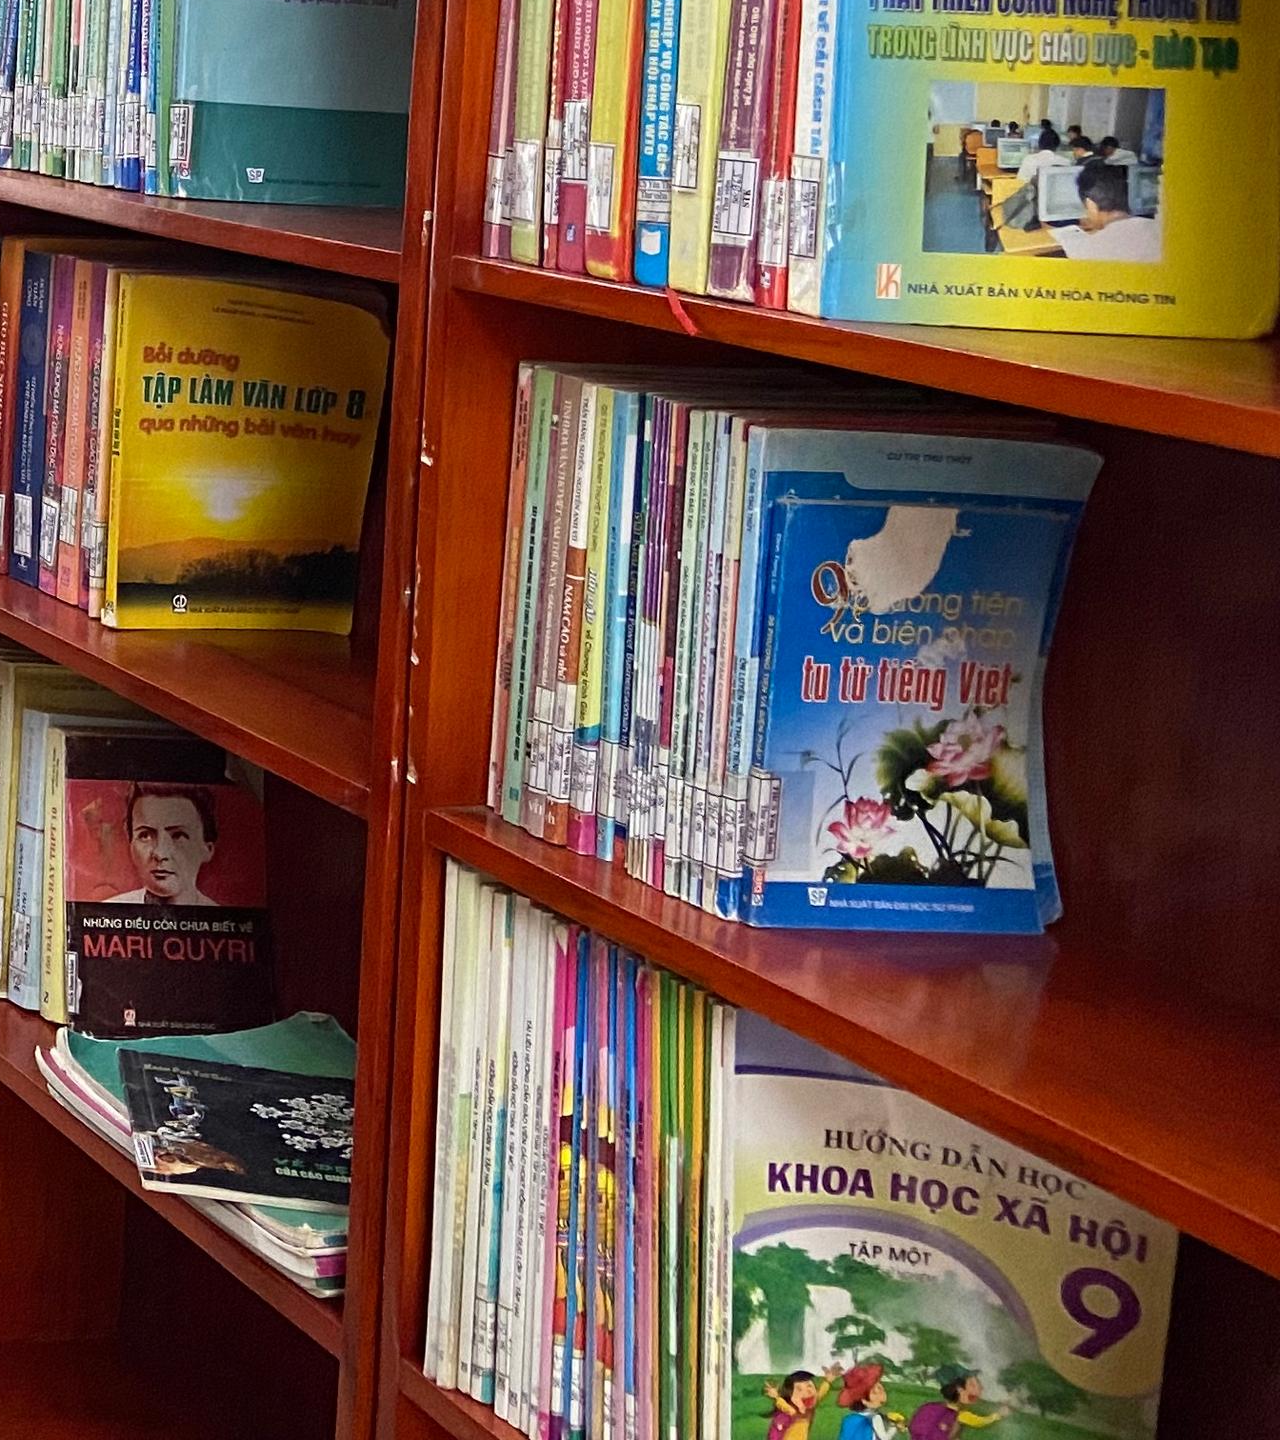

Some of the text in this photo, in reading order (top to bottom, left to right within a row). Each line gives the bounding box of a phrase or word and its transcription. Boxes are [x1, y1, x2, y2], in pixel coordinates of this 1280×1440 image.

[868, 25, 936, 60] TRONG
[940, 22, 987, 62] LĨNH
[991, 31, 1033, 72] VỰC
[1039, 27, 1088, 66] GIÁO
[1092, 35, 1137, 75] DỤC
[907, 281, 1149, 305] NHÀ XUẤT BẢN VĂN THÔNG
[142, 342, 240, 372] Bồi dưỡng
[142, 372, 366, 420] TẬP LÀM VĂN LỚP 8
[180, 414, 275, 438] những bài
[829, 618, 863, 644] và
[801, 655, 1013, 712] tu từ tiếng Việt
[810, 889, 826, 904] SP
[82, 913, 235, 933] NHỮNG ĐIỀU CÒN CHƯA BIẾT
[82, 934, 255, 964] MARI QUYRI
[823, 1125, 1090, 1201] HƯỚNG DẪN HỌC
[767, 1161, 1149, 1265] KHOA HỌC XÃ HỘI
[848, 1241, 932, 1268] TẬP MỘT
[1059, 1266, 1143, 1360] 9
